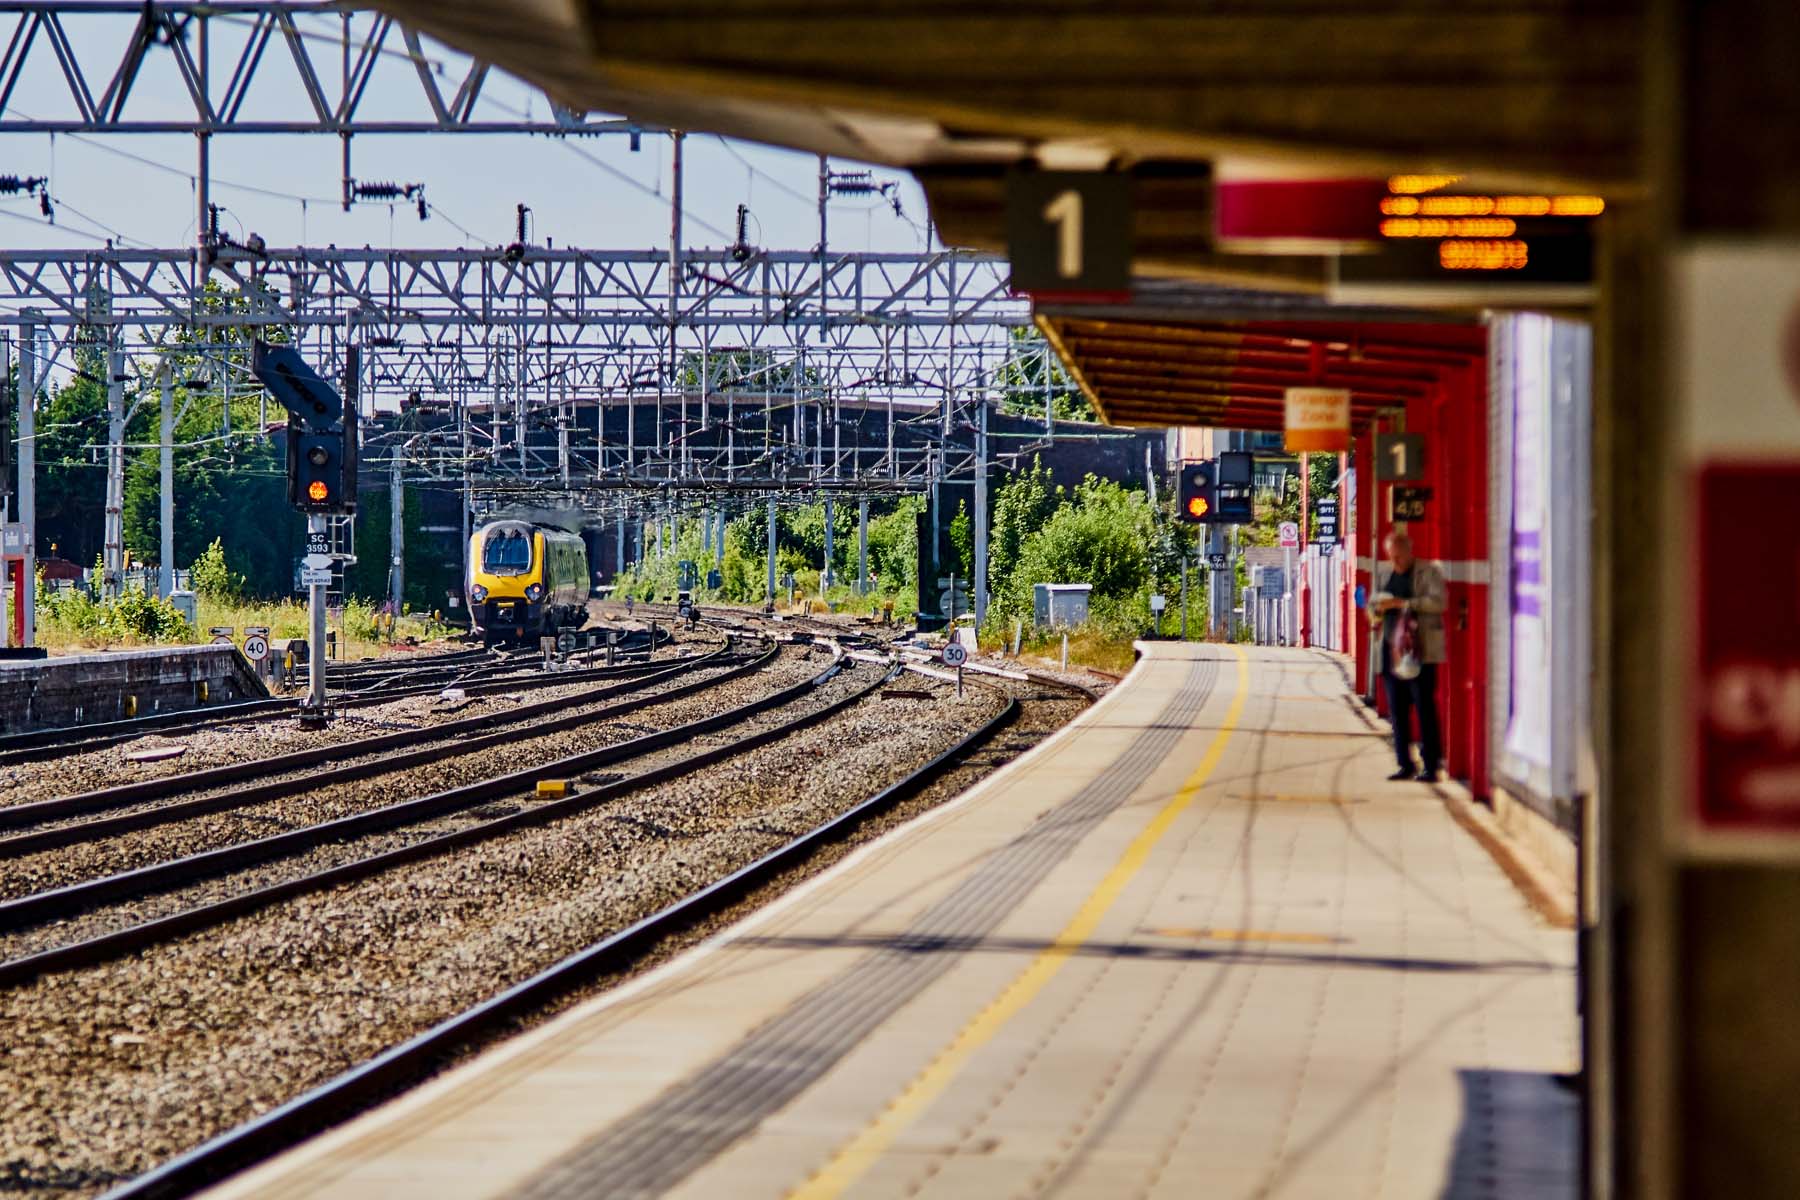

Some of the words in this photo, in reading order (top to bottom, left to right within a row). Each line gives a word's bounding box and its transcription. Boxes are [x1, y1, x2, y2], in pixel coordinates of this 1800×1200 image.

[1043, 190, 1083, 278] 1
[1390, 443, 1407, 476] 1
[311, 534, 325, 543] SC
[306, 544, 329, 553] 3593
[1320, 543, 1333, 554] 12
[247, 642, 264, 654] 40
[946, 648, 963, 661] 30
